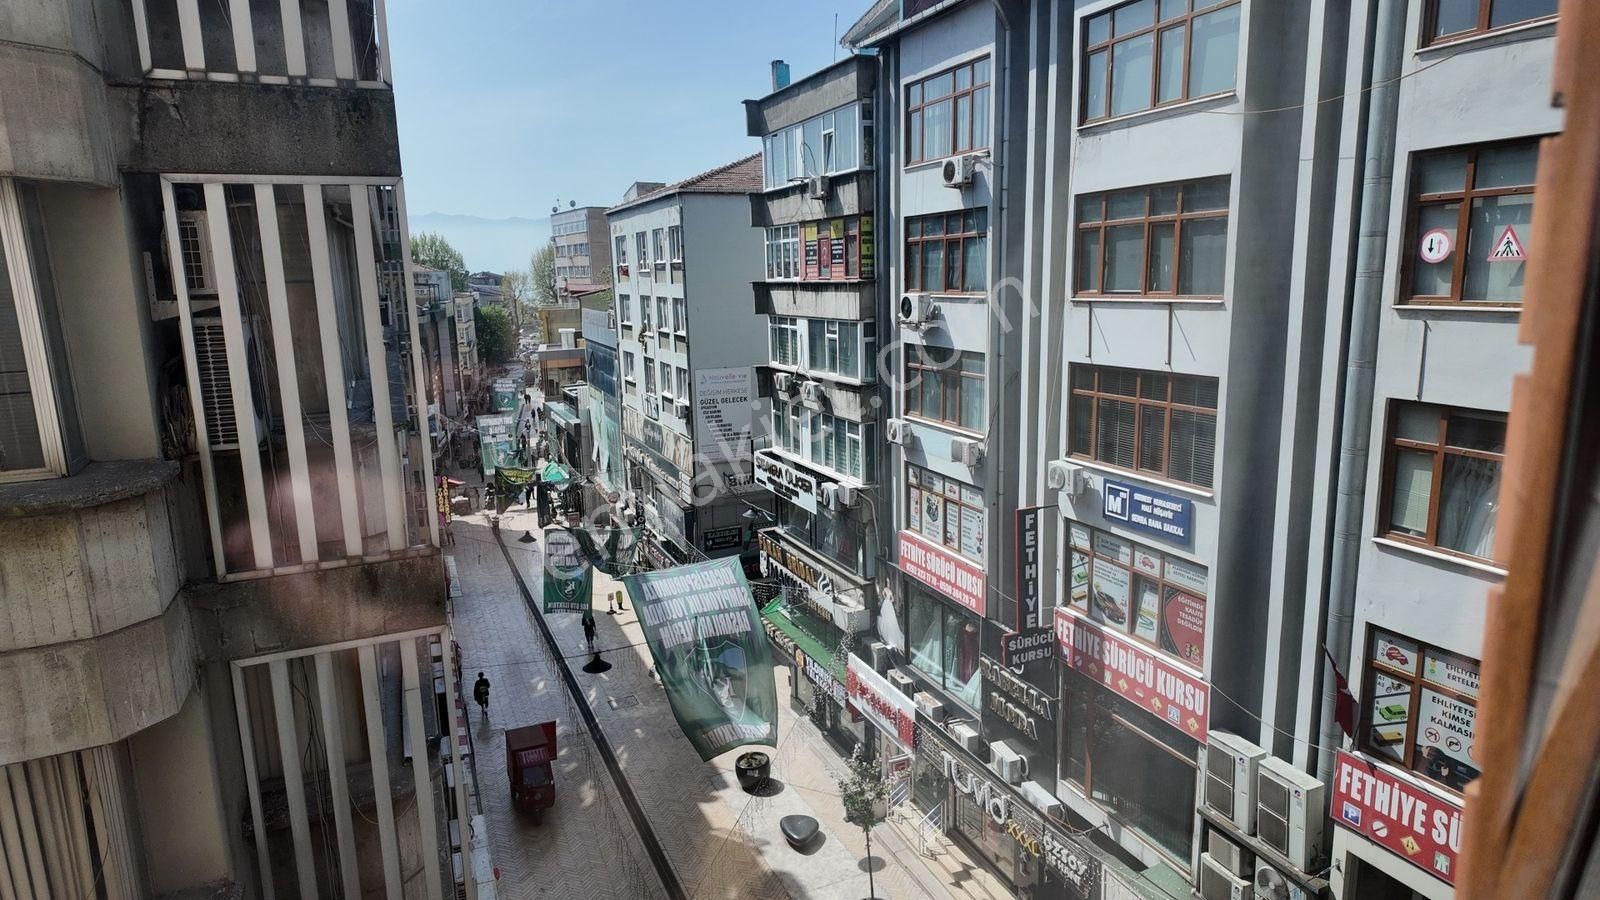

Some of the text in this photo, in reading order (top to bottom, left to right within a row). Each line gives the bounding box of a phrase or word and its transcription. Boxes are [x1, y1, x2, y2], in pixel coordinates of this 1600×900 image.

[700, 396, 748, 406] GÜZEL GELECEK
[900, 538, 983, 599] FETHİYE SÜRÜCÜ KURSU
[1025, 513, 1037, 629] FETHİYE
[1008, 629, 1055, 651] SÜRÜCÜ
[1012, 647, 1052, 665] KURSU
[1057, 617, 1205, 717] FETHİYE SÜRÜCÜ KURSU
[1441, 710, 1472, 728] KİMSE
[1340, 763, 1429, 836] FETHİYE
